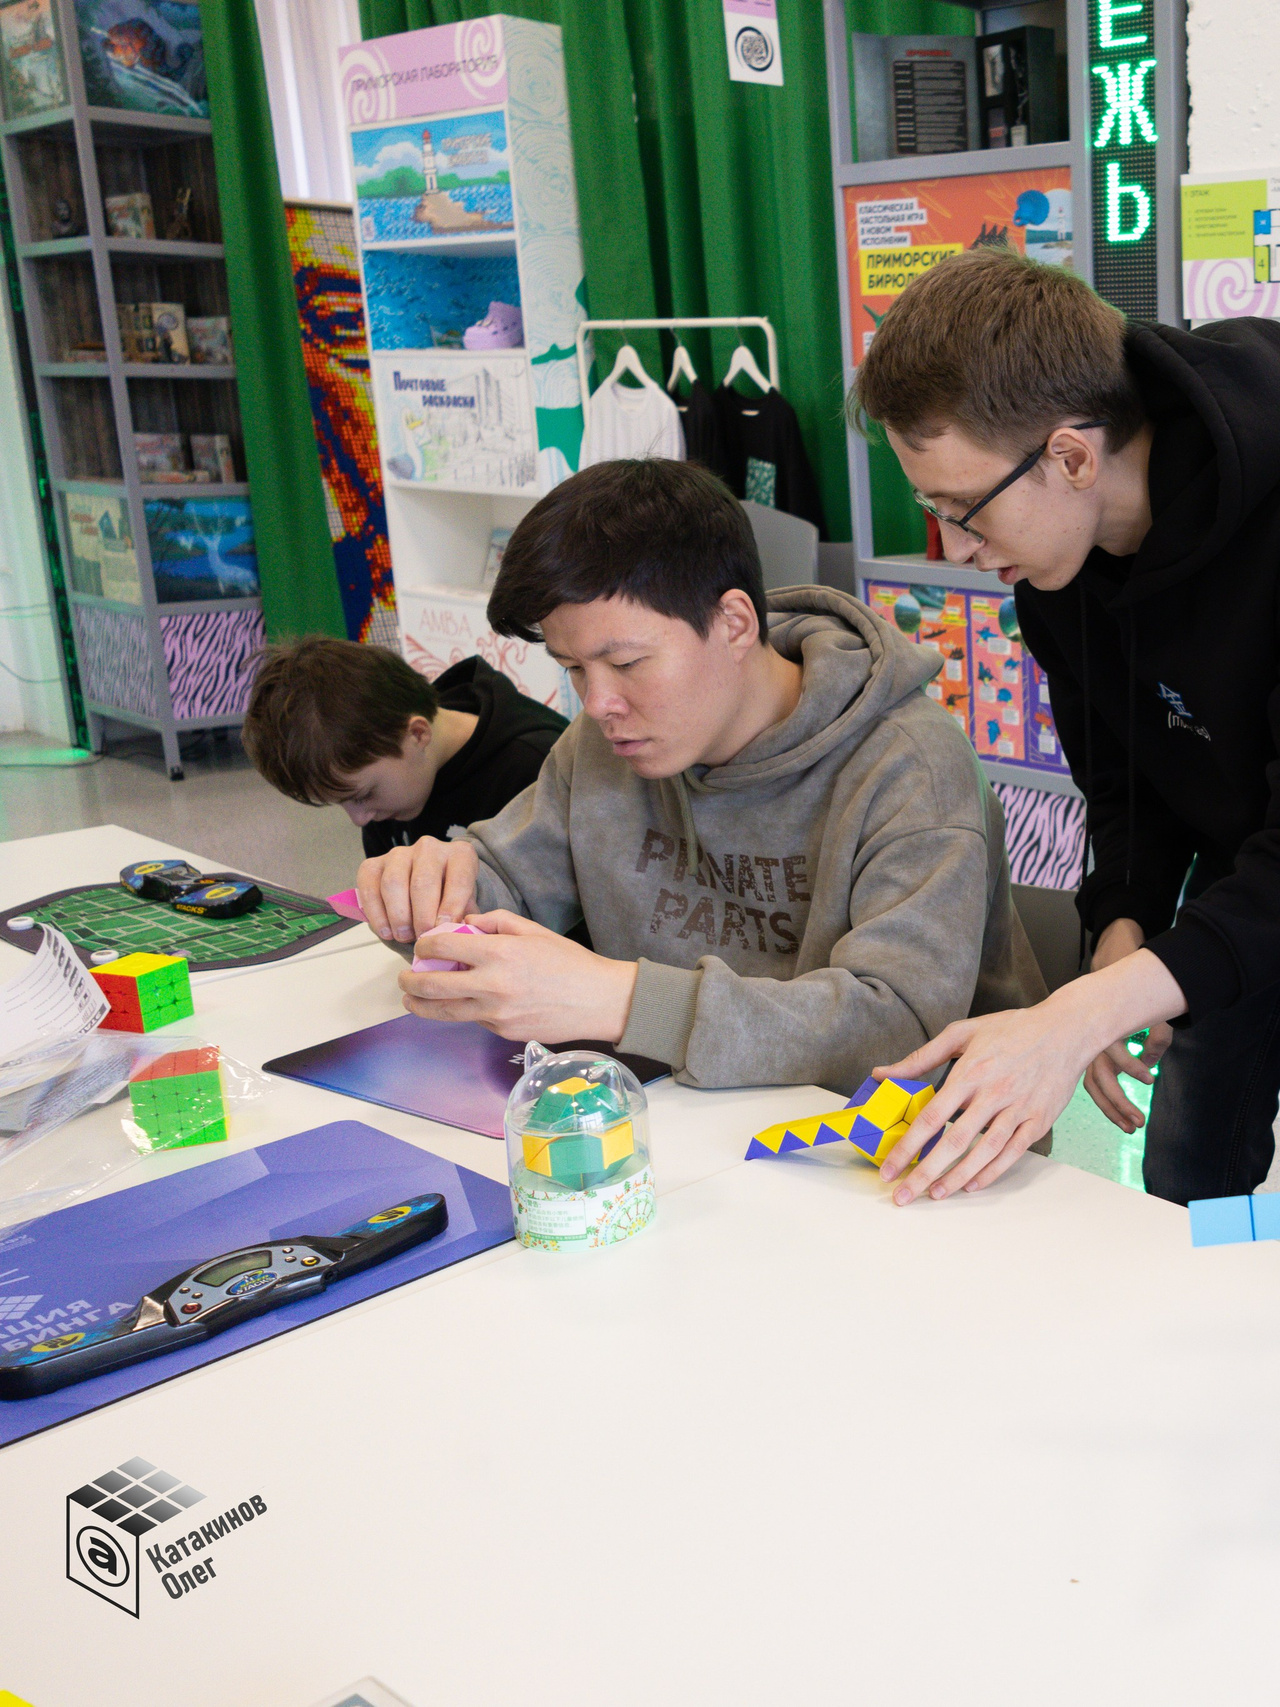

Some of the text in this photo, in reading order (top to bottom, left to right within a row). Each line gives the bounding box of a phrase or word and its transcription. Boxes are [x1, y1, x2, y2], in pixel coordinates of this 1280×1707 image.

[859, 202, 914, 214] КЛАССИЧЕСКАЯ
[860, 212, 924, 225] НАСТОЛЬНАЯ ИГРА
[867, 226, 892, 235] НОВОМ
[866, 250, 956, 269] ПРИМОРСКИ
[1258, 259, 1265, 269] 4
[868, 273, 915, 289] БИРЮЛ
[175, 903, 205, 915] STACKS
[650, 888, 800, 955] PARTS
[0, 1299, 93, 1339] ЦИЯ
